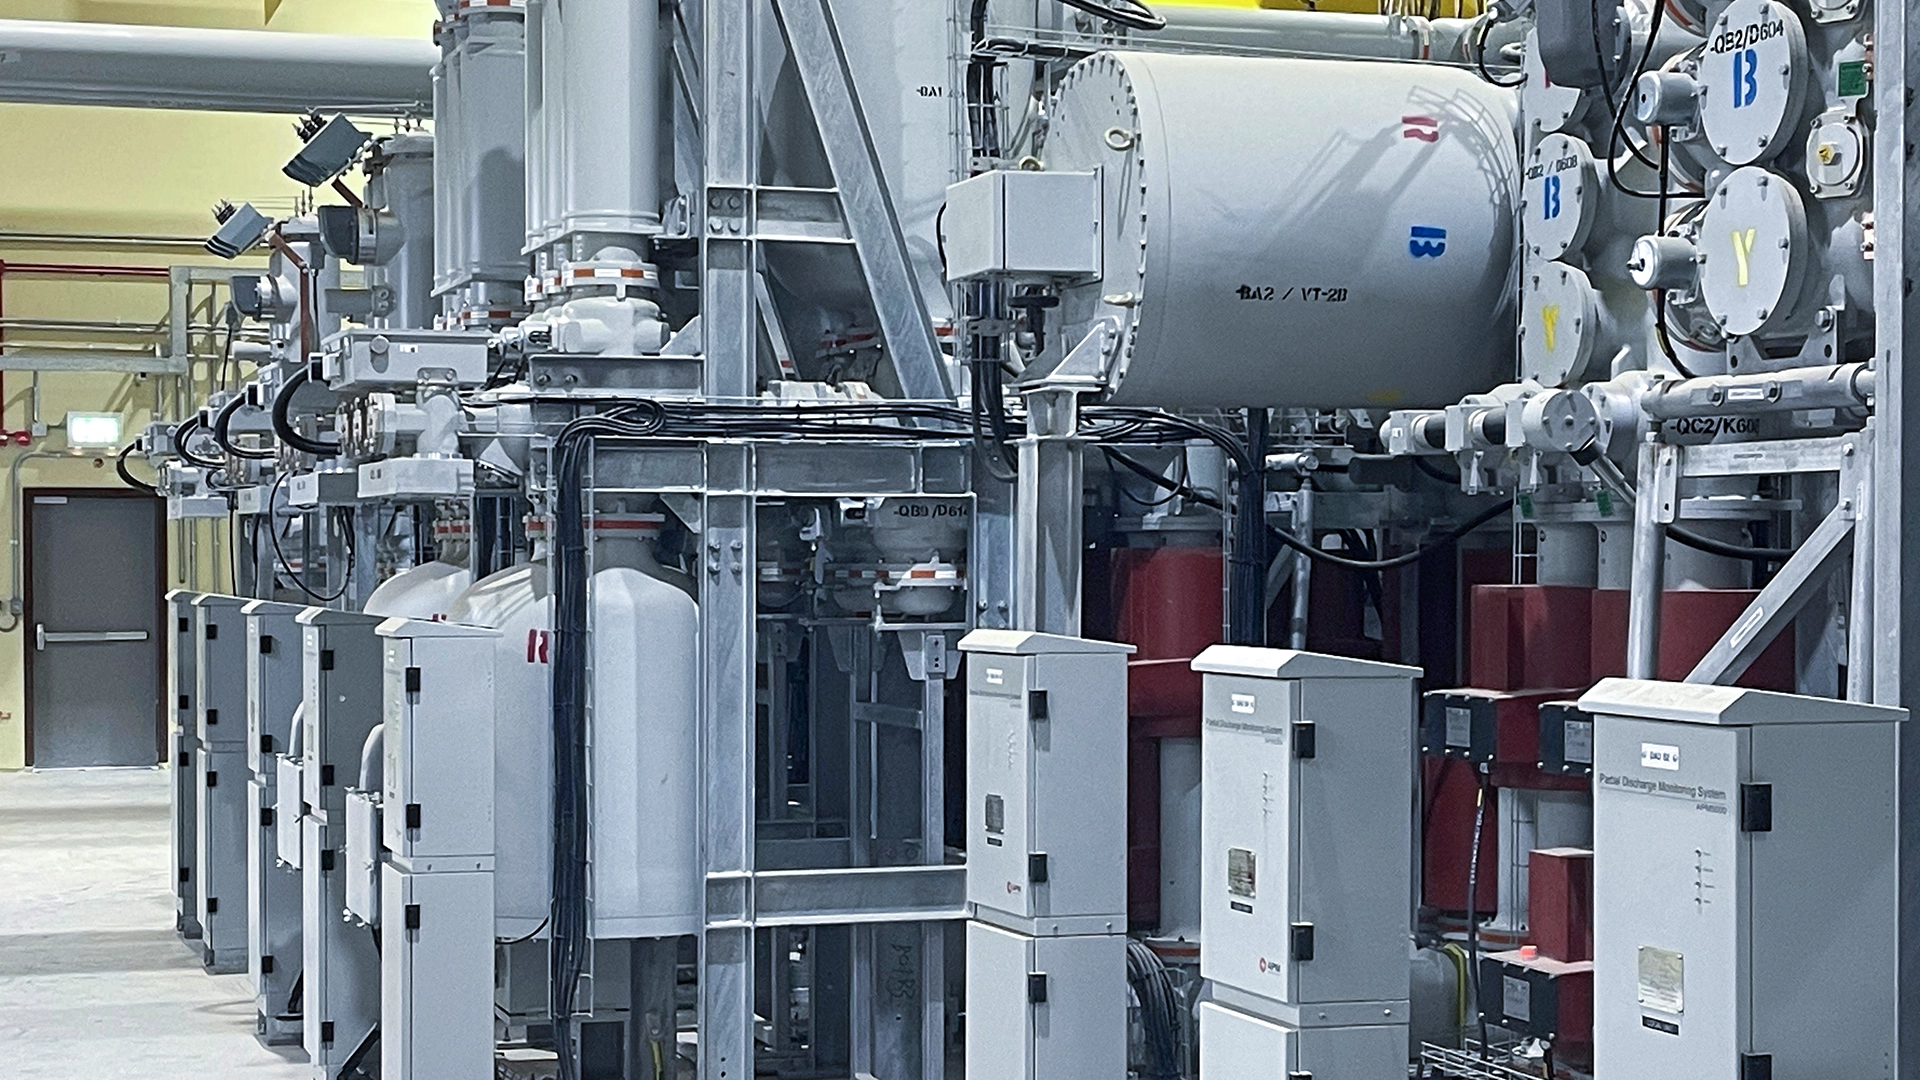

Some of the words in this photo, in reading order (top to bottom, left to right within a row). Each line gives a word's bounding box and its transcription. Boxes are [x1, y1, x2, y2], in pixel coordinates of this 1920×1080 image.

[1710, 18, 1784, 54] -QB2/D604
[1733, 48, 1758, 109] B
[1544, 175, 1561, 220] B
[1410, 226, 1447, 258] B
[1731, 227, 1756, 287] Y
[1542, 303, 1560, 352] Y
[1621, 775, 1657, 793] Discharge
[1697, 786, 1727, 800] System
